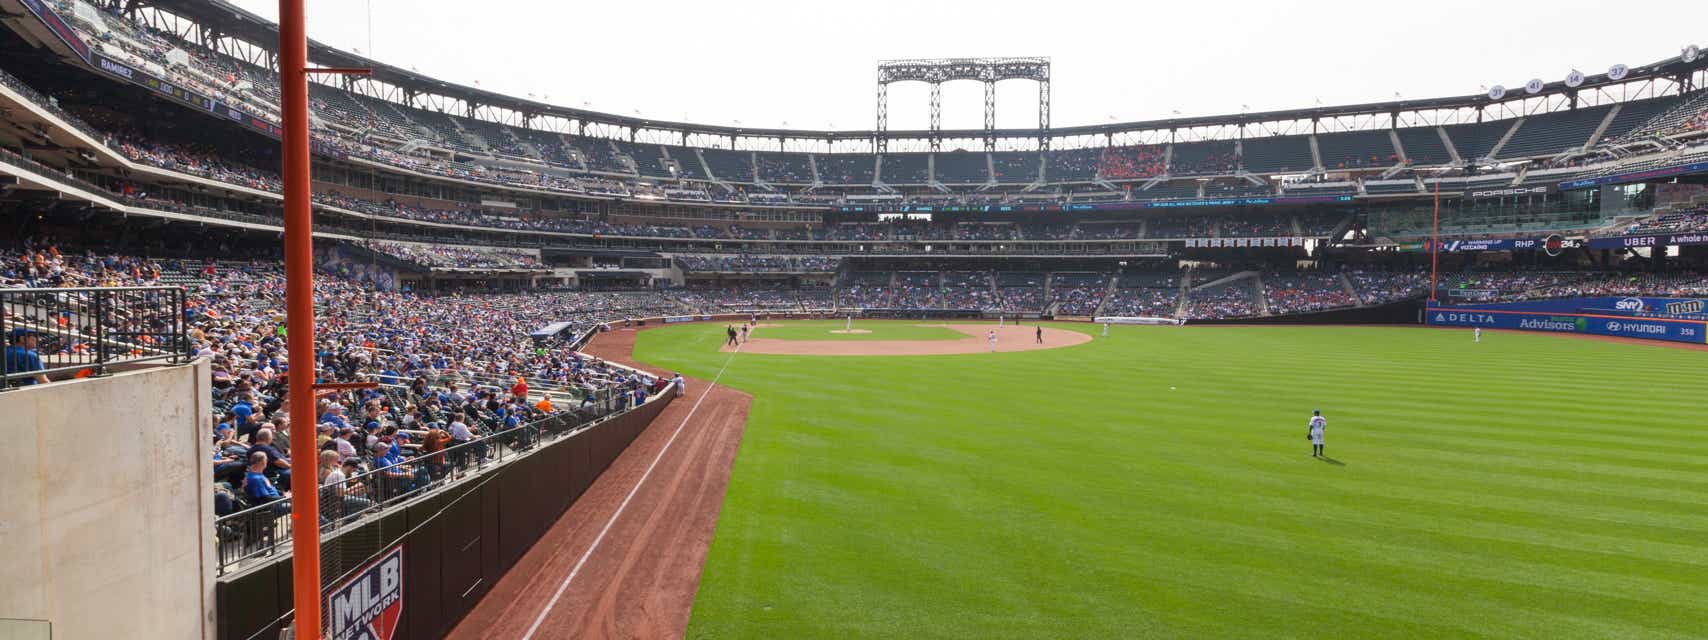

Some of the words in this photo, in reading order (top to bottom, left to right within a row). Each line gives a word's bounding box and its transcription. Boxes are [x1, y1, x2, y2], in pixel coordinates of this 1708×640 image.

[101, 60, 133, 79] RAMIREZ
[1472, 186, 1547, 197] PORSCHE
[1624, 236, 1655, 246] UBER
[1677, 234, 1701, 243] whole
[1514, 240, 1534, 248] RHP
[1615, 301, 1638, 310] SNY
[1449, 313, 1495, 323] DELTA
[1519, 318, 1575, 330] Advisors
[1623, 323, 1666, 334] HYUNDAI
[334, 556, 399, 638] MLB
